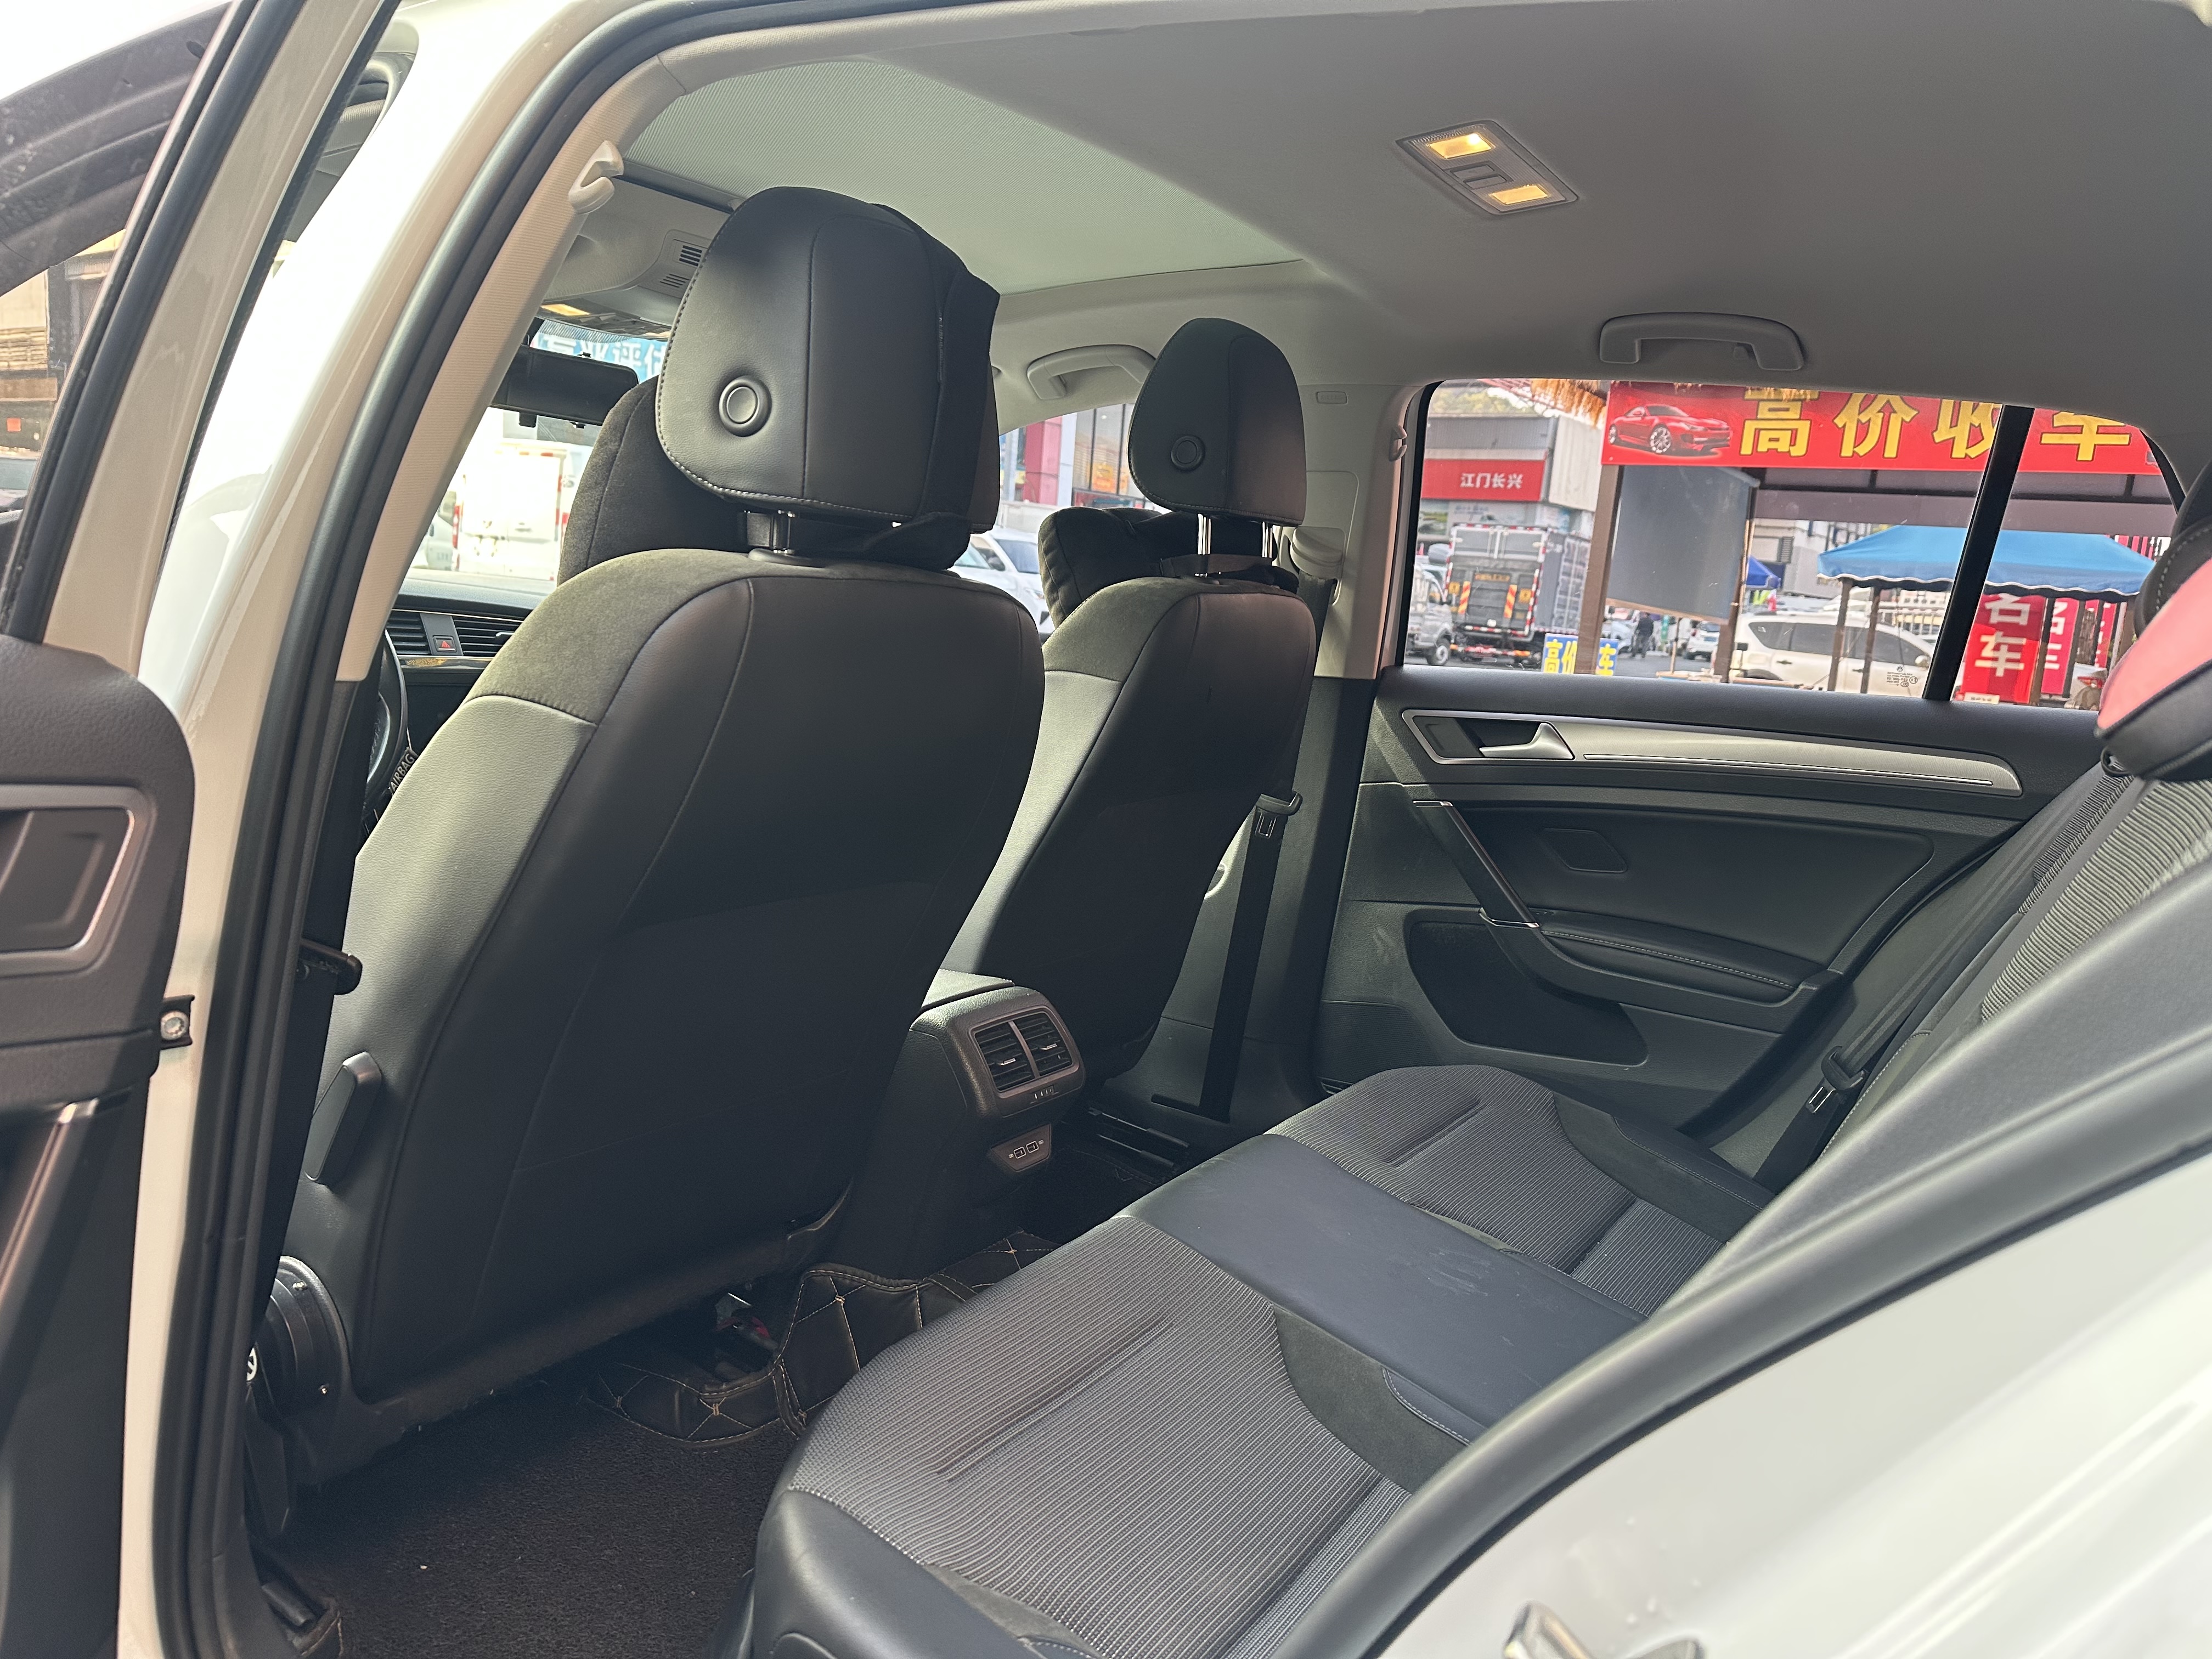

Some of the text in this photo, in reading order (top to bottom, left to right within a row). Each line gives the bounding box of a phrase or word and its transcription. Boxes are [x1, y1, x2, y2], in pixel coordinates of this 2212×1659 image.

[1740, 387, 2131, 461] 高价收车
[1460, 472, 1523, 489] 江门长兴
[1543, 639, 1617, 676] 高价车
[390, 753, 415, 792] AIRBAG
